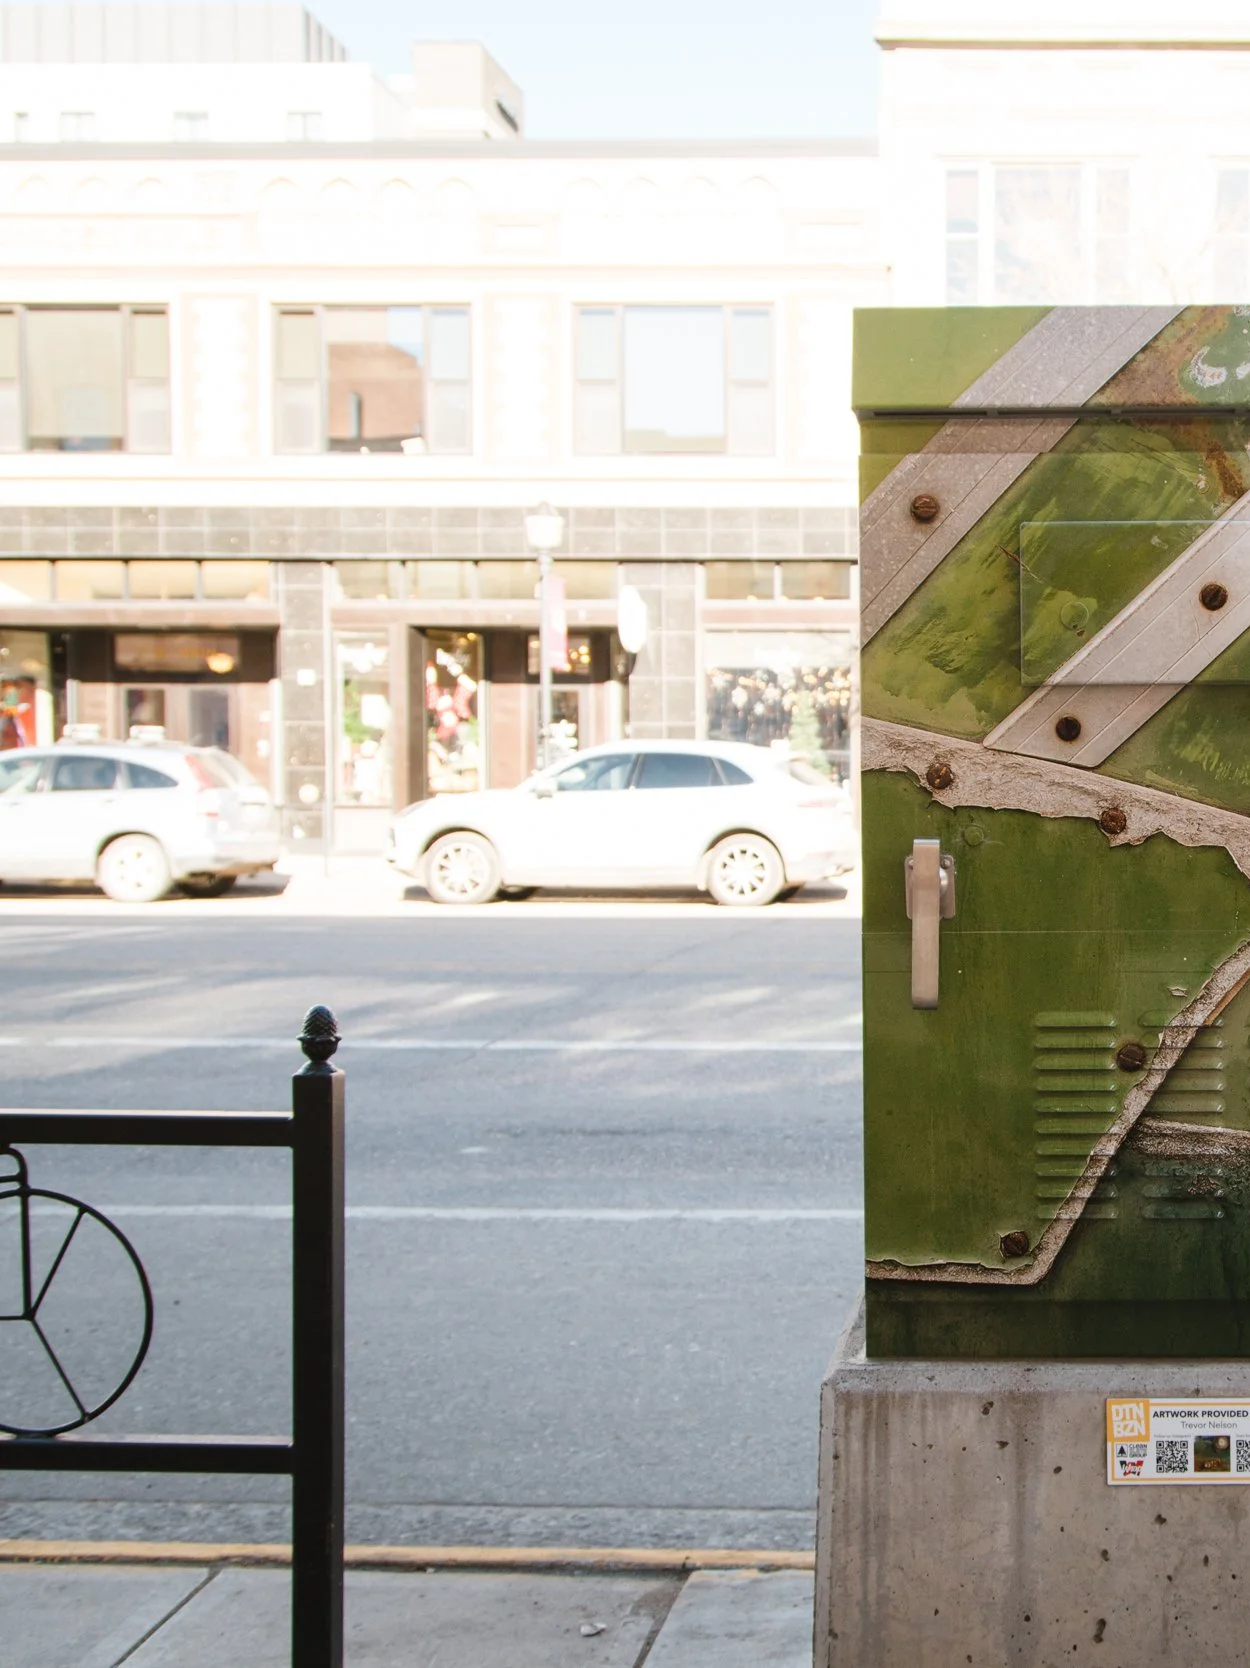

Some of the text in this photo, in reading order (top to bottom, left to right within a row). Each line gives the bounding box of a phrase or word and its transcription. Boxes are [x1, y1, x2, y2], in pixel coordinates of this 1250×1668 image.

[1112, 1403, 1144, 1421] DTN
[1152, 1410, 1199, 1418] ARTWORK
[1201, 1410, 1249, 1418] PROVIDED
[1114, 1421, 1147, 1438] BZN
[1181, 1421, 1238, 1429] Trevor Nelson
